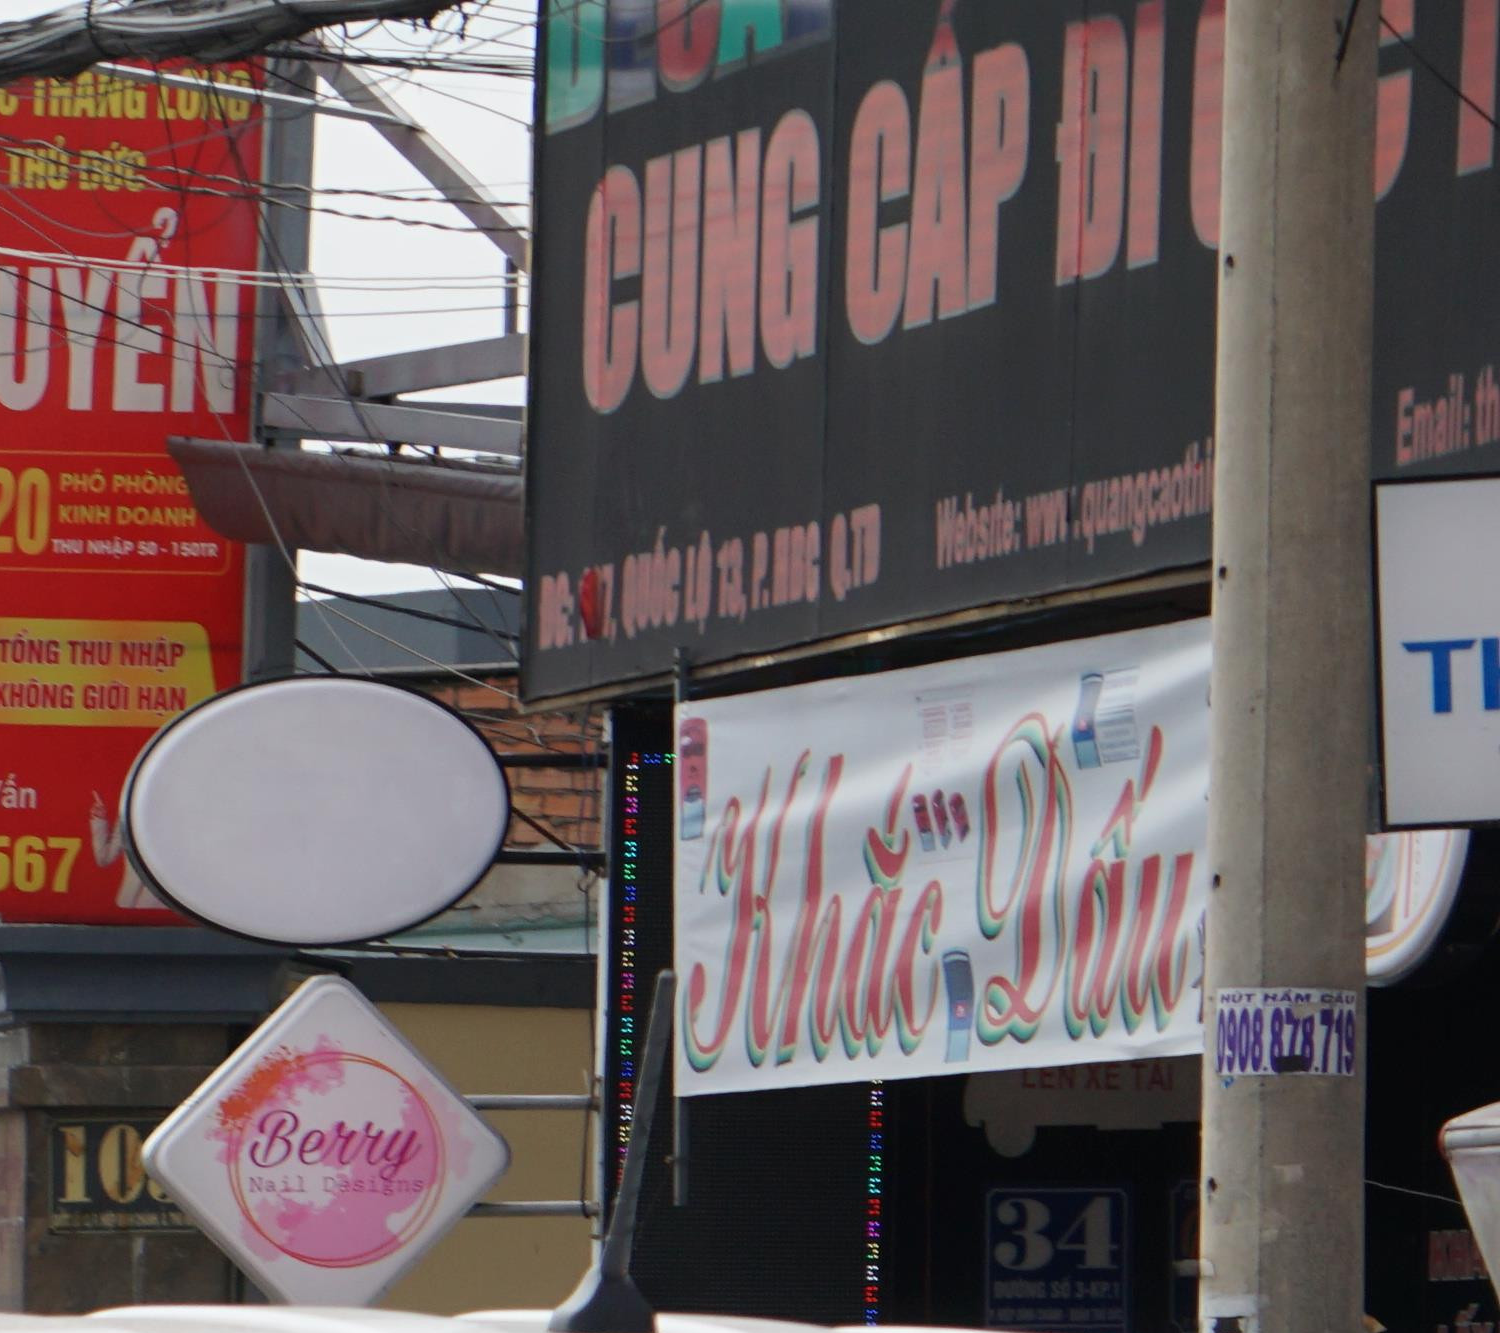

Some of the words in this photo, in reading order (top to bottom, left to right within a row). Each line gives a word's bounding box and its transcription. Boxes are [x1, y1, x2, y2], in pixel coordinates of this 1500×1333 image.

[583, 108, 820, 414] CUNG
[845, 0, 1030, 346] CẤP
[57, 504, 111, 526] KINH
[116, 505, 198, 529] DOANH
[51, 537, 84, 556] THU
[67, 639, 116, 668] THU
[119, 636, 187, 674] NHẬP
[81, 678, 132, 711] GIỚI
[136, 685, 187, 719] HẠN
[685, 748, 944, 1073] Khắc
[975, 711, 1197, 1046] Dấu
[1216, 1007, 1357, 1074] 0908.878.719
[1084, 1063, 1120, 1092] XE
[249, 1109, 423, 1180] Berry
[248, 1175, 305, 1193] Nail
[321, 1175, 425, 1199] Designs
[994, 1196, 1119, 1272] 34
